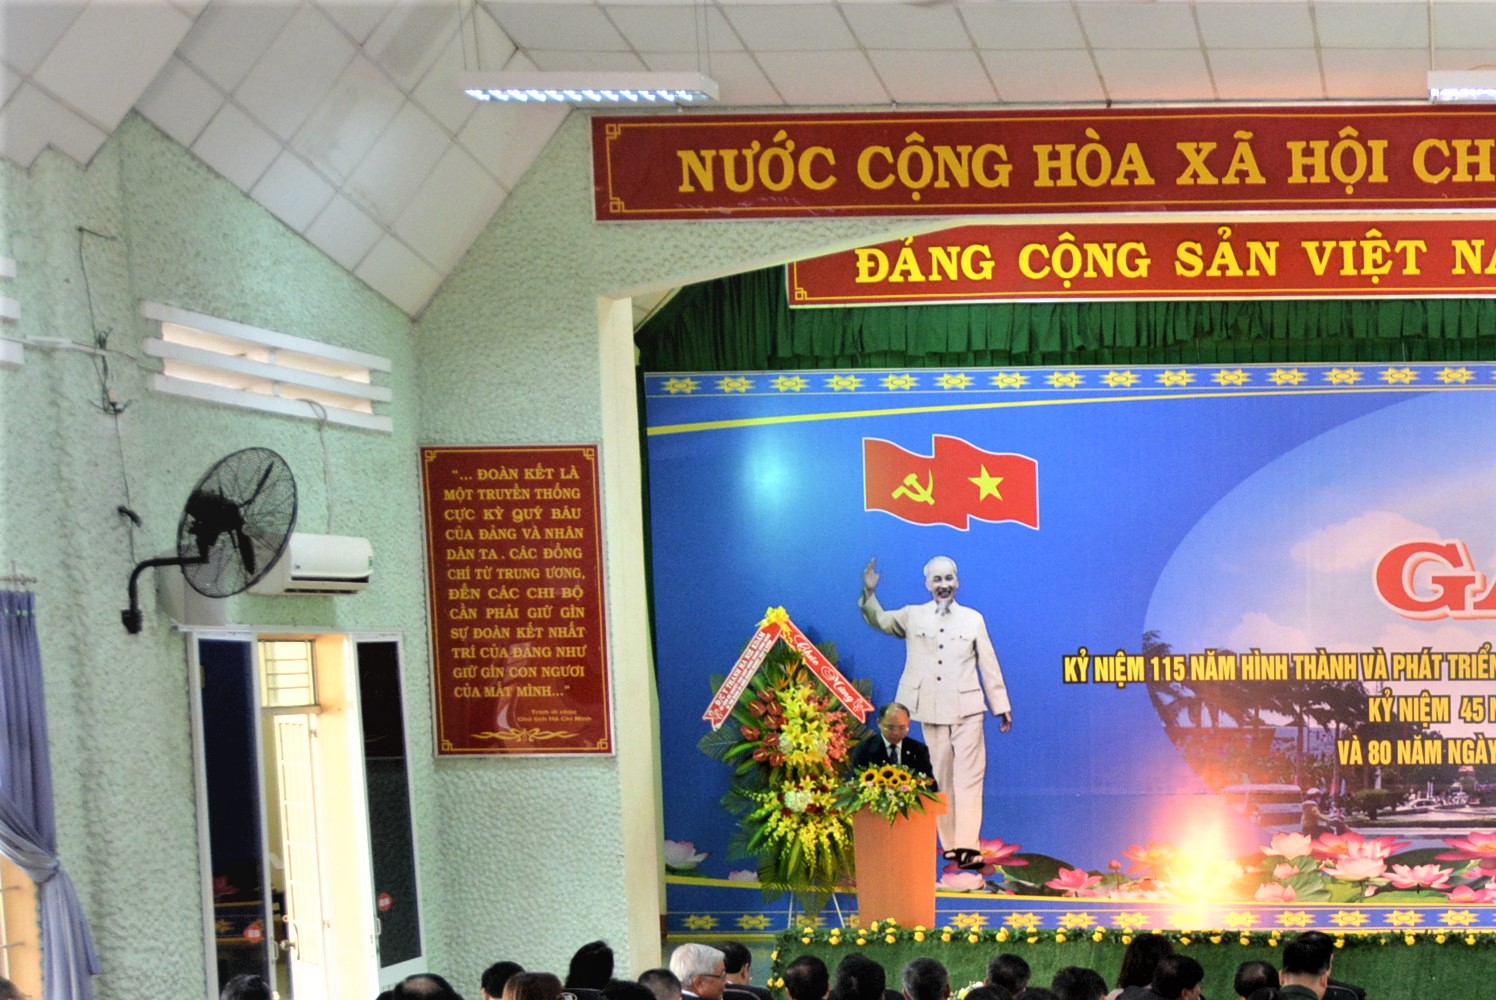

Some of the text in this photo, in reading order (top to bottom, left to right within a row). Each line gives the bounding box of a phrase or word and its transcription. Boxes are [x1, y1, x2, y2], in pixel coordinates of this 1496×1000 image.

[678, 130, 836, 192] NƯỚC
[858, 132, 1012, 198] CỘNG
[1034, 128, 1155, 187] HÒA
[1177, 131, 1265, 185] XÃ
[1288, 127, 1388, 194] HỘI
[1019, 232, 1151, 289] CỘNG
[1176, 226, 1279, 277] SẢN
[1302, 229, 1427, 278] VIỆT
[1064, 648, 1090, 682] KỶ
[1094, 650, 1145, 688] NIỆM
[1150, 655, 1186, 682] 115
[1190, 650, 1237, 681] NĂM
[1241, 650, 1289, 681] HÌNH
[1293, 649, 1357, 681] THÀNH
[1361, 649, 1388, 680] VÀ
[1392, 649, 1443, 680] PHÁT
[1368, 688, 1394, 723] KỶ
[1398, 691, 1450, 728] NIỆM
[1460, 696, 1485, 723] 45
[1337, 735, 1363, 765] VÀ
[1367, 739, 1392, 766] 80
[1396, 735, 1443, 765] NĂM
